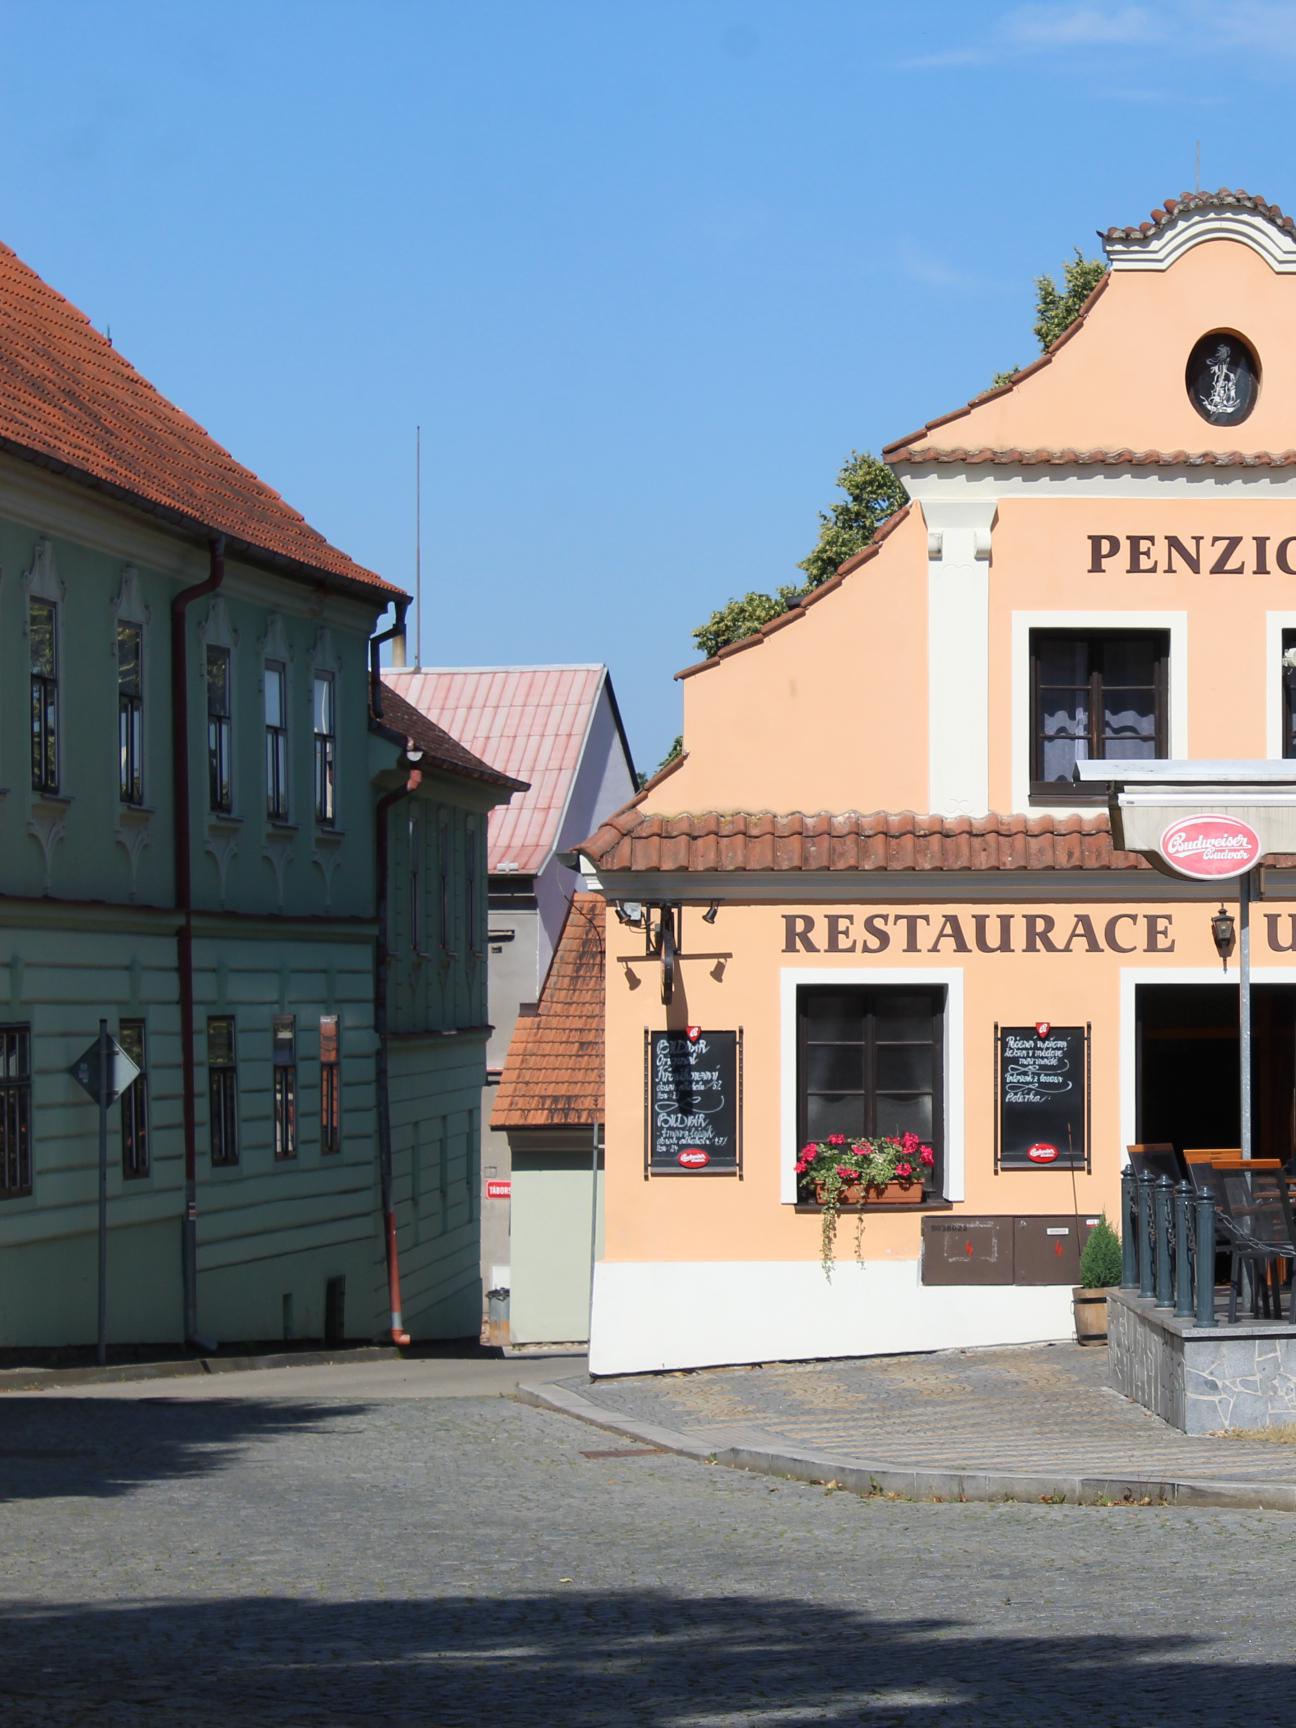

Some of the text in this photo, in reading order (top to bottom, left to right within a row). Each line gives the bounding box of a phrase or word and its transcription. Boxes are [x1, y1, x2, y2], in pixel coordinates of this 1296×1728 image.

[1167, 832, 1252, 855] Budweiser
[1203, 847, 1250, 861] Budvar
[781, 913, 1176, 954] RESTAURACE
